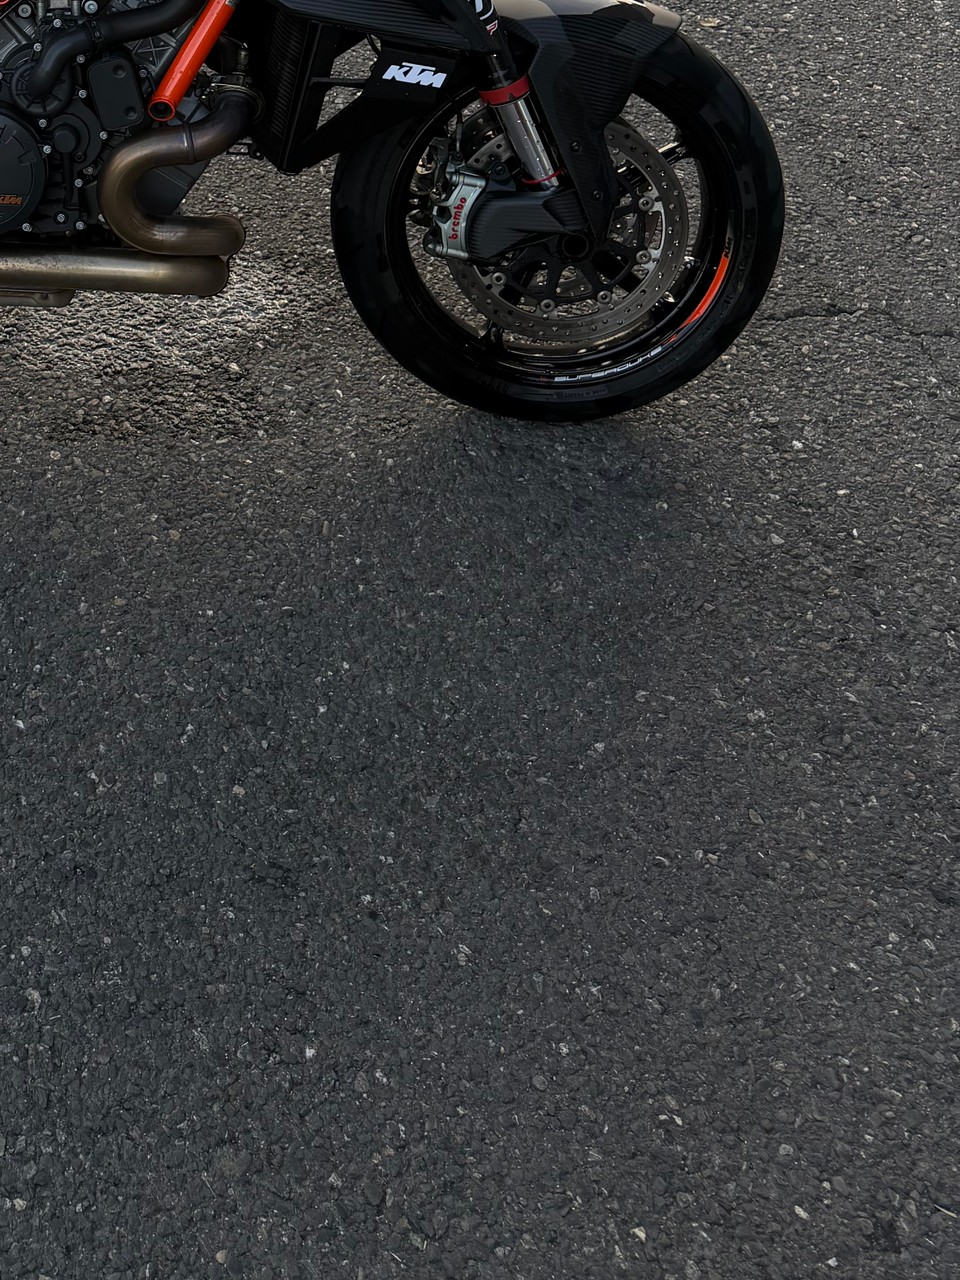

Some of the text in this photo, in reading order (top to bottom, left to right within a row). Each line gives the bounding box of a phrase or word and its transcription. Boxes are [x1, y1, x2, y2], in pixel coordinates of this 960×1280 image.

[382, 61, 447, 89] KTM
[448, 197, 467, 240] brembo
[553, 345, 663, 382] SUPERDUKE
